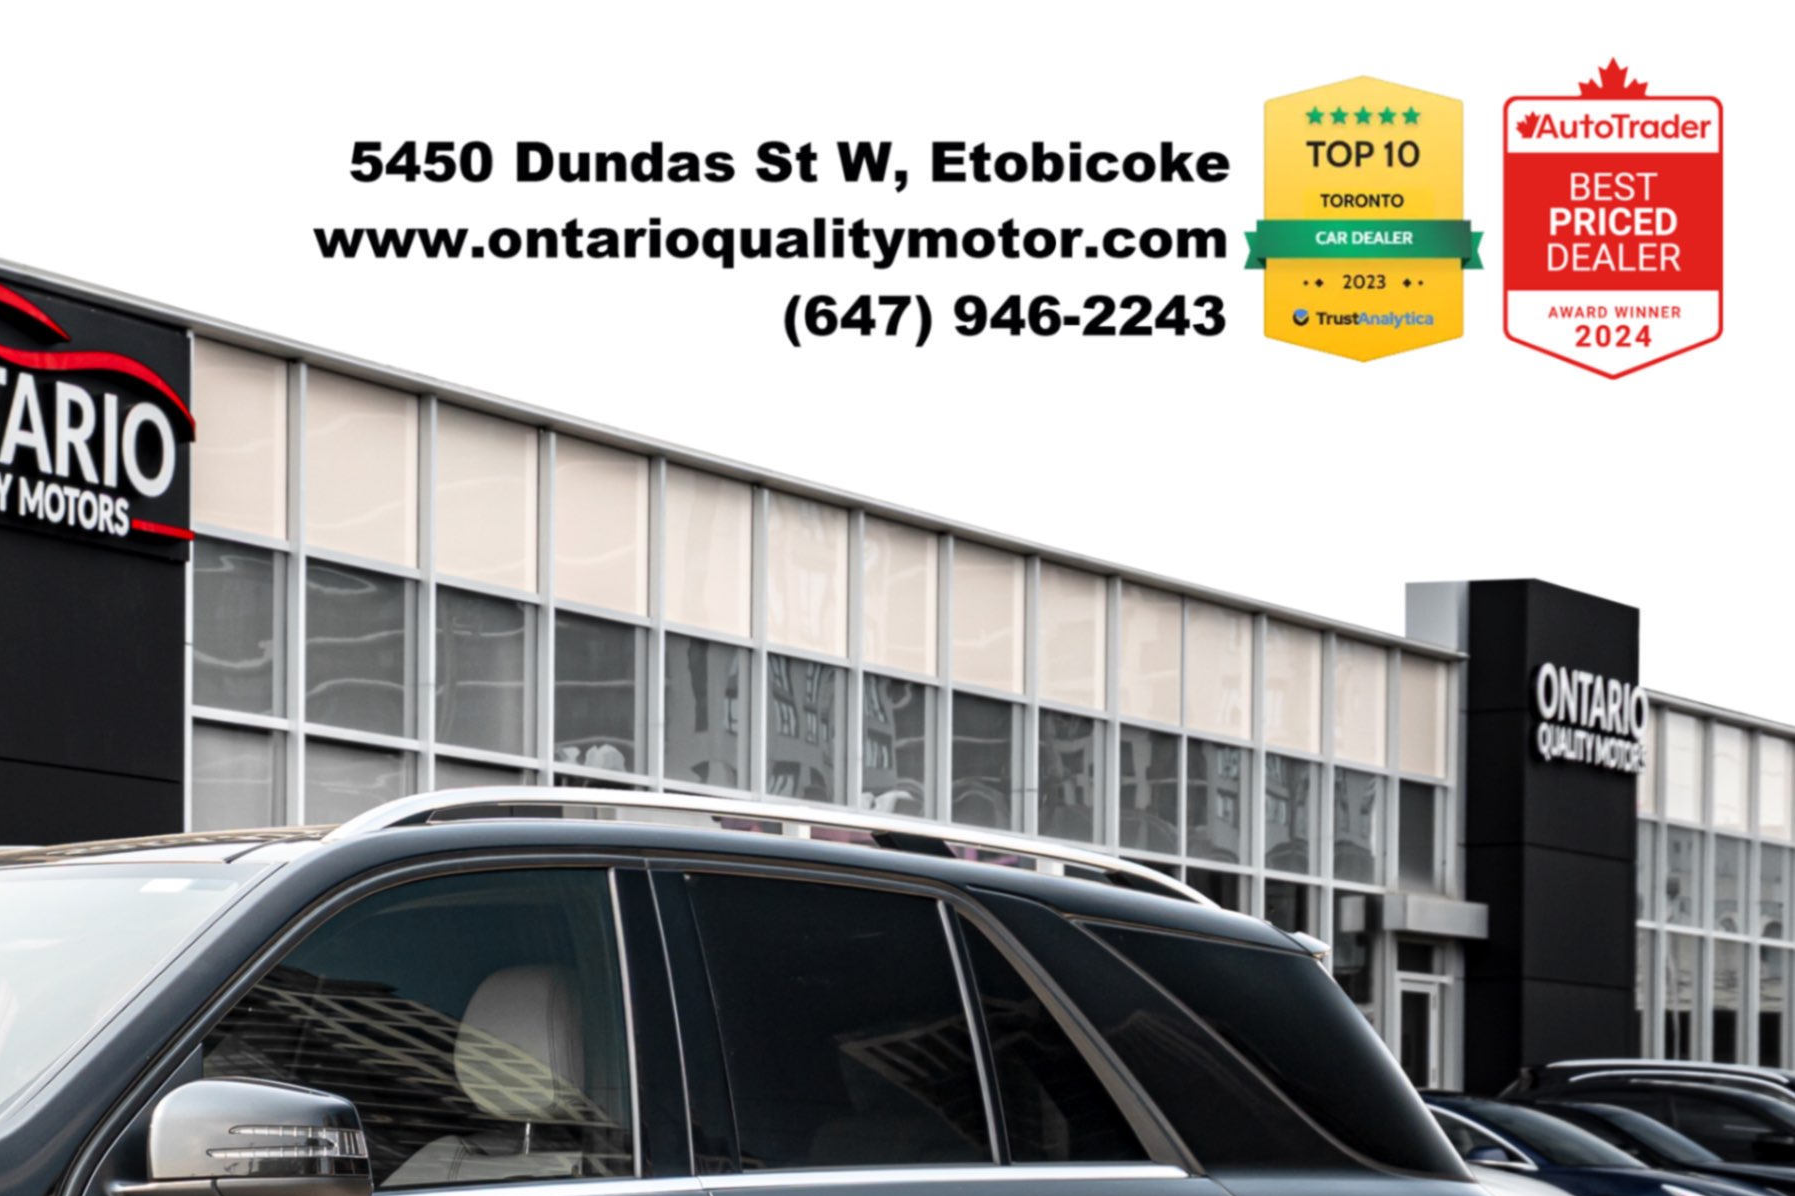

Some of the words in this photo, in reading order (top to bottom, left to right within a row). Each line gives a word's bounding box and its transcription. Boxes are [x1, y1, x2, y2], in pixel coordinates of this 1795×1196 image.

[18, 476, 131, 537] MOTORS
[1536, 661, 1649, 741] ONTARIO
[1536, 721, 1594, 763] QUALITY
[1594, 732, 1647, 774] MOTORS
